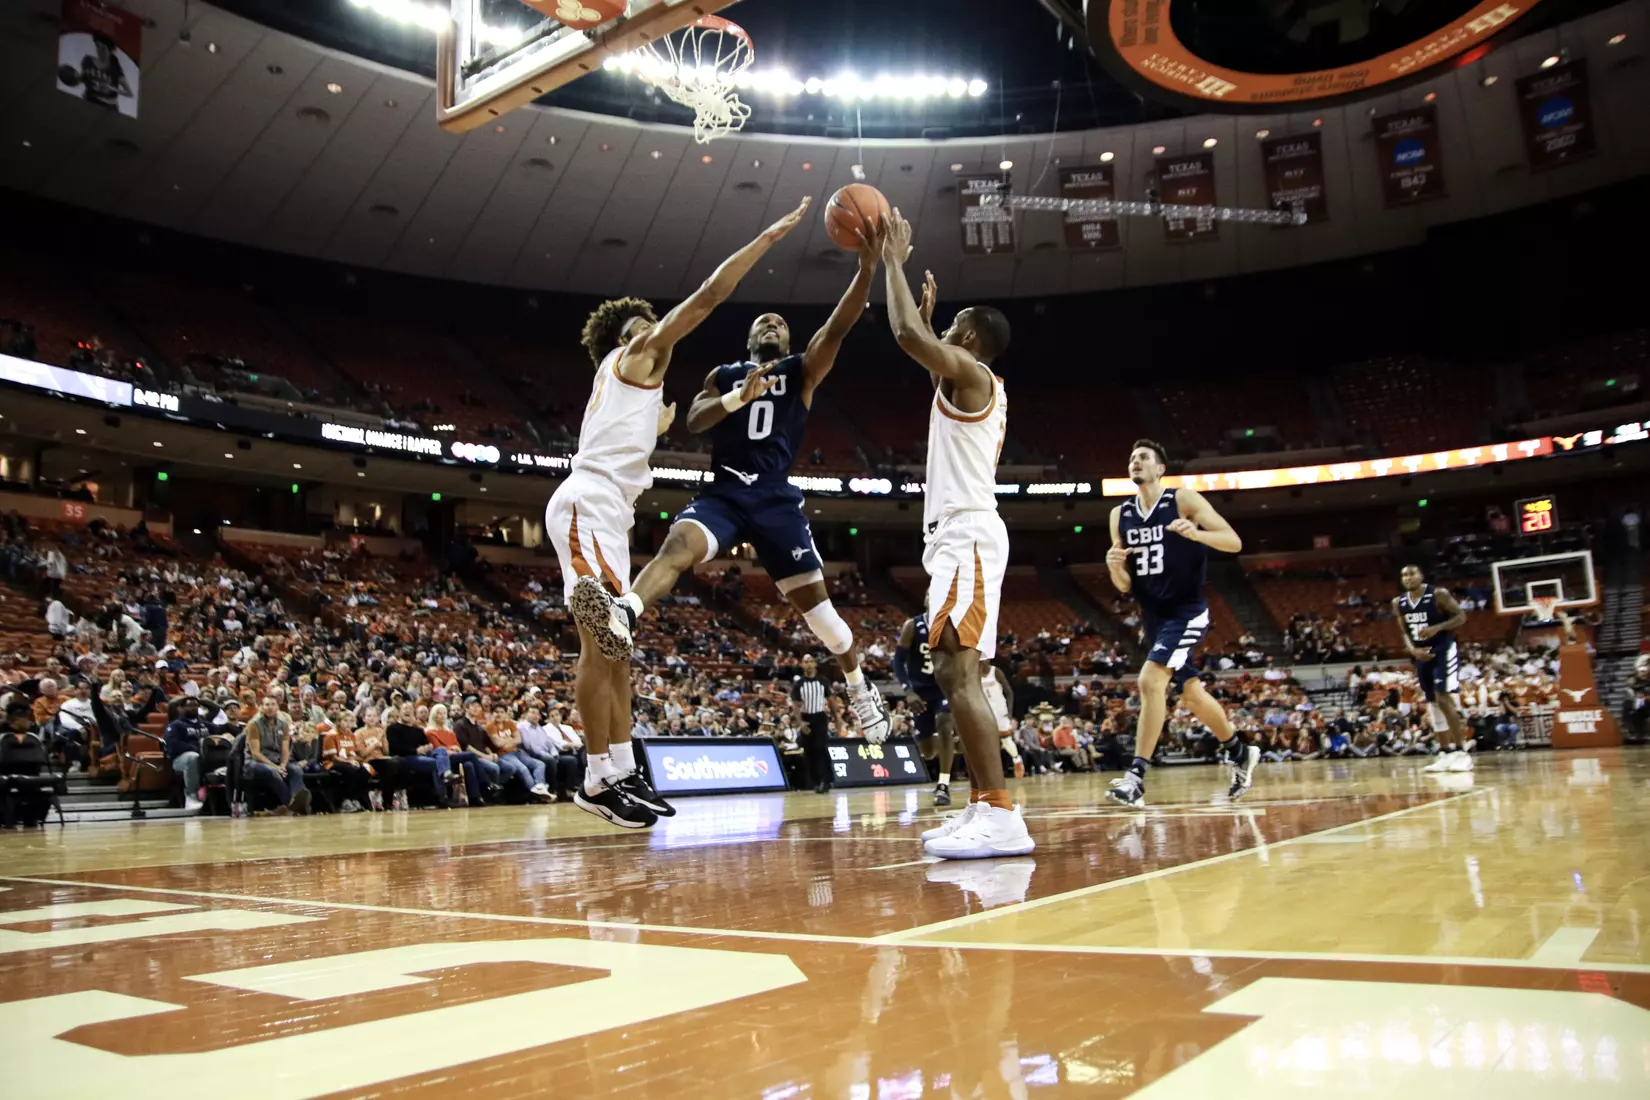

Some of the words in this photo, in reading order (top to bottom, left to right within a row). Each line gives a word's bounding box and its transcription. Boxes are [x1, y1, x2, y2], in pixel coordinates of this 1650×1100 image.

[1071, 172, 1104, 183] TEXAS
[748, 400, 774, 440] 0
[1522, 510, 1552, 532] 20
[1126, 524, 1164, 545] CBU
[1132, 543, 1164, 576] 33
[1404, 611, 1428, 623] CBU
[662, 755, 759, 780] Southwest
